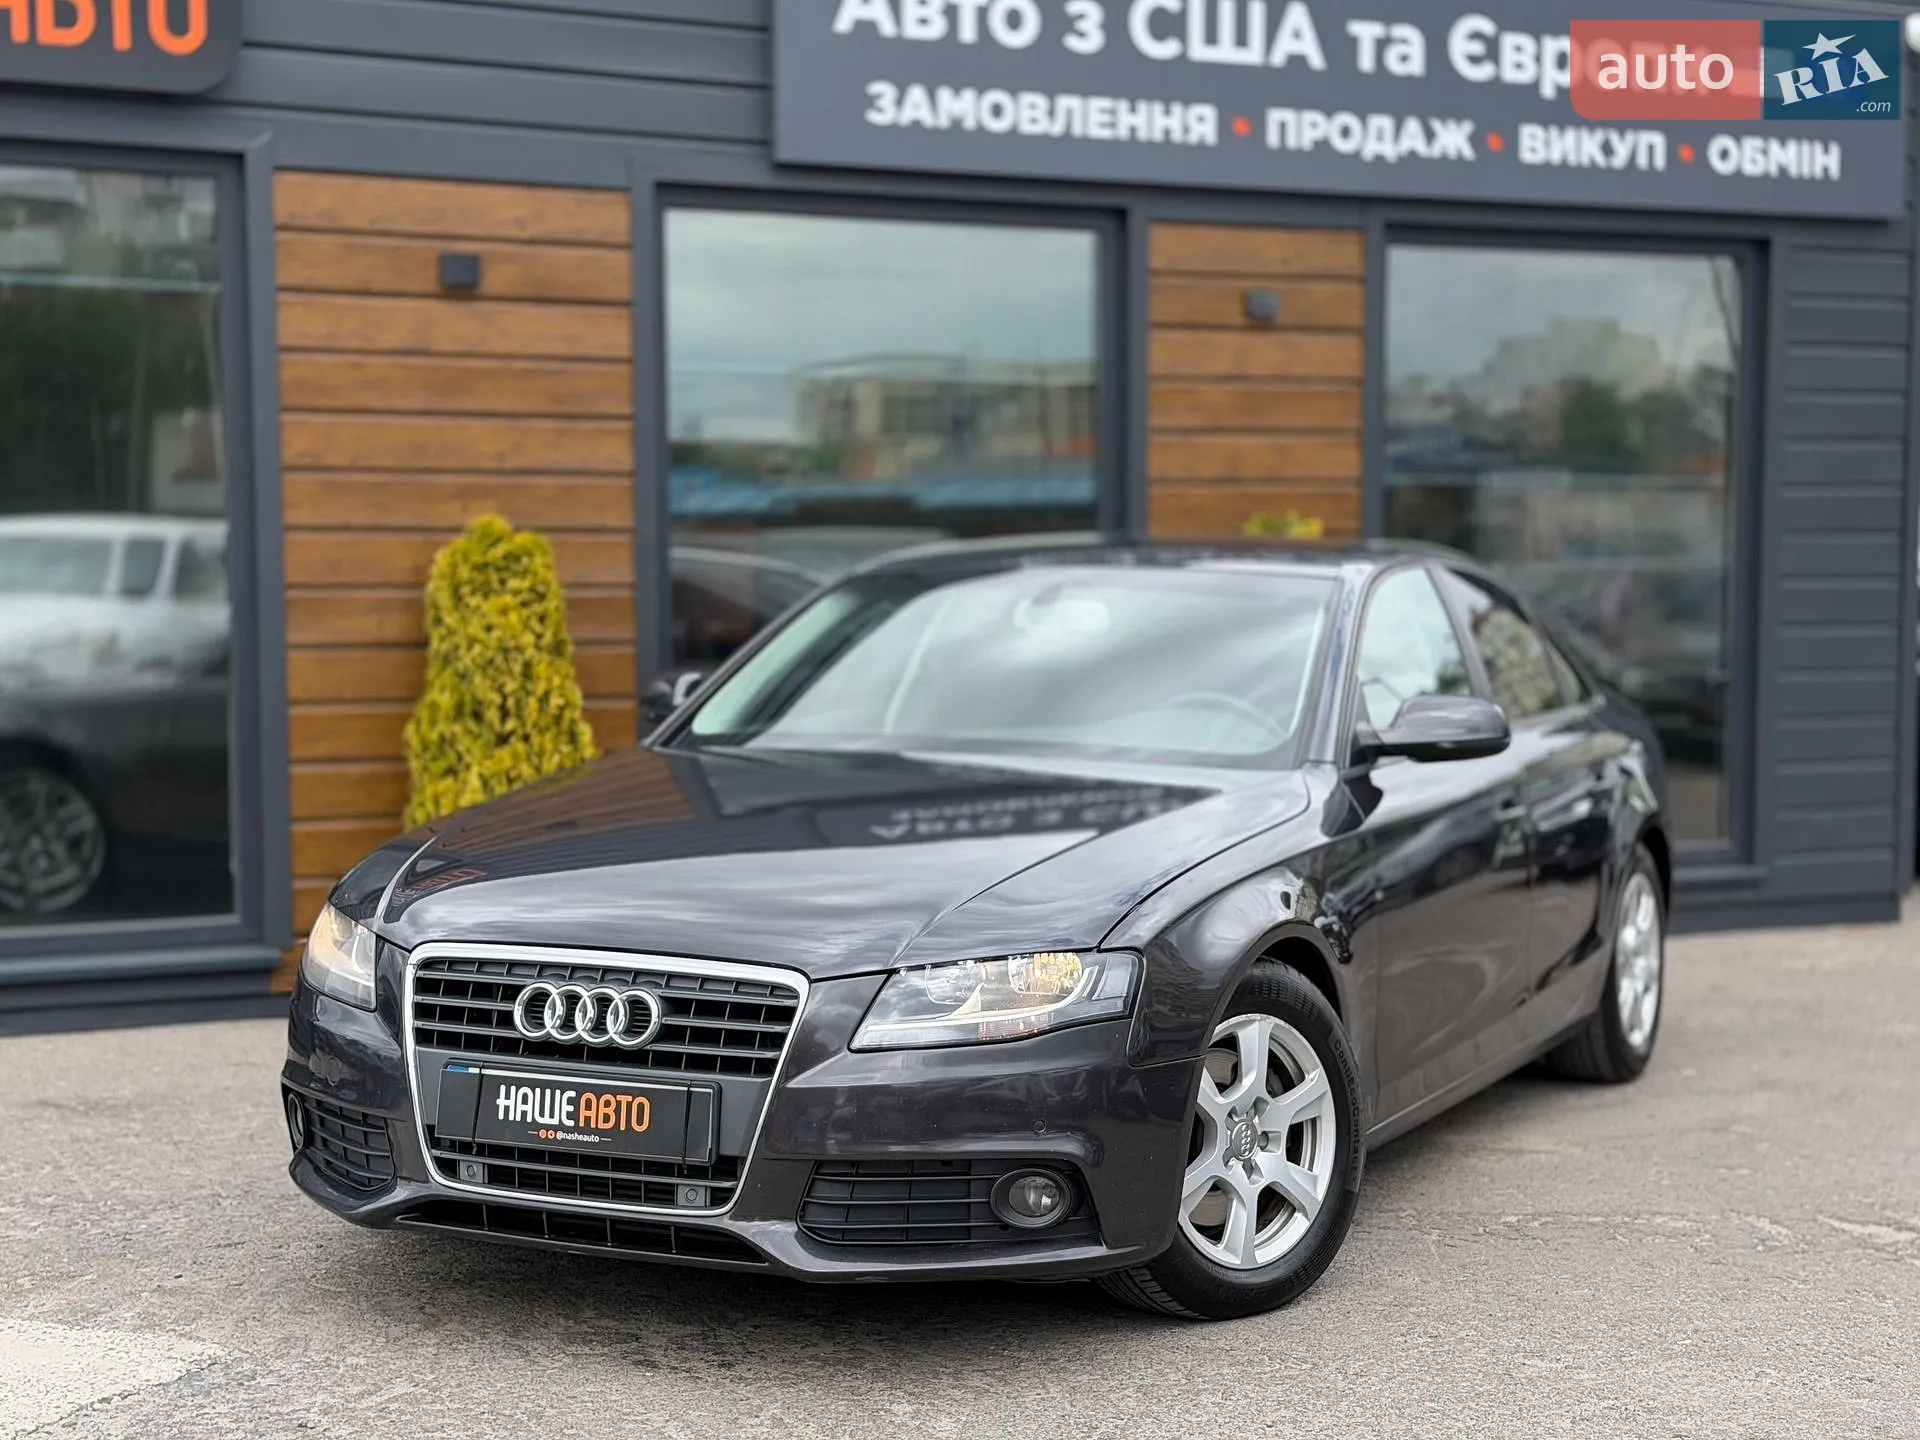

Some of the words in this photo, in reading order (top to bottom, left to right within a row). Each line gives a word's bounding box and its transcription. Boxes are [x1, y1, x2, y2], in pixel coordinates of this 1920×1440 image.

[1128, 0, 1326, 71] США
[1346, 20, 1426, 77] та
[864, 80, 1218, 146] ЗАМОВЛЕННЯ
[1265, 107, 1475, 163] ПРОДАЖ
[1518, 122, 1667, 171] ВИКУП
[1707, 134, 1841, 181] ОБМІН
[556, 1130, 600, 1143] @nasheauto
